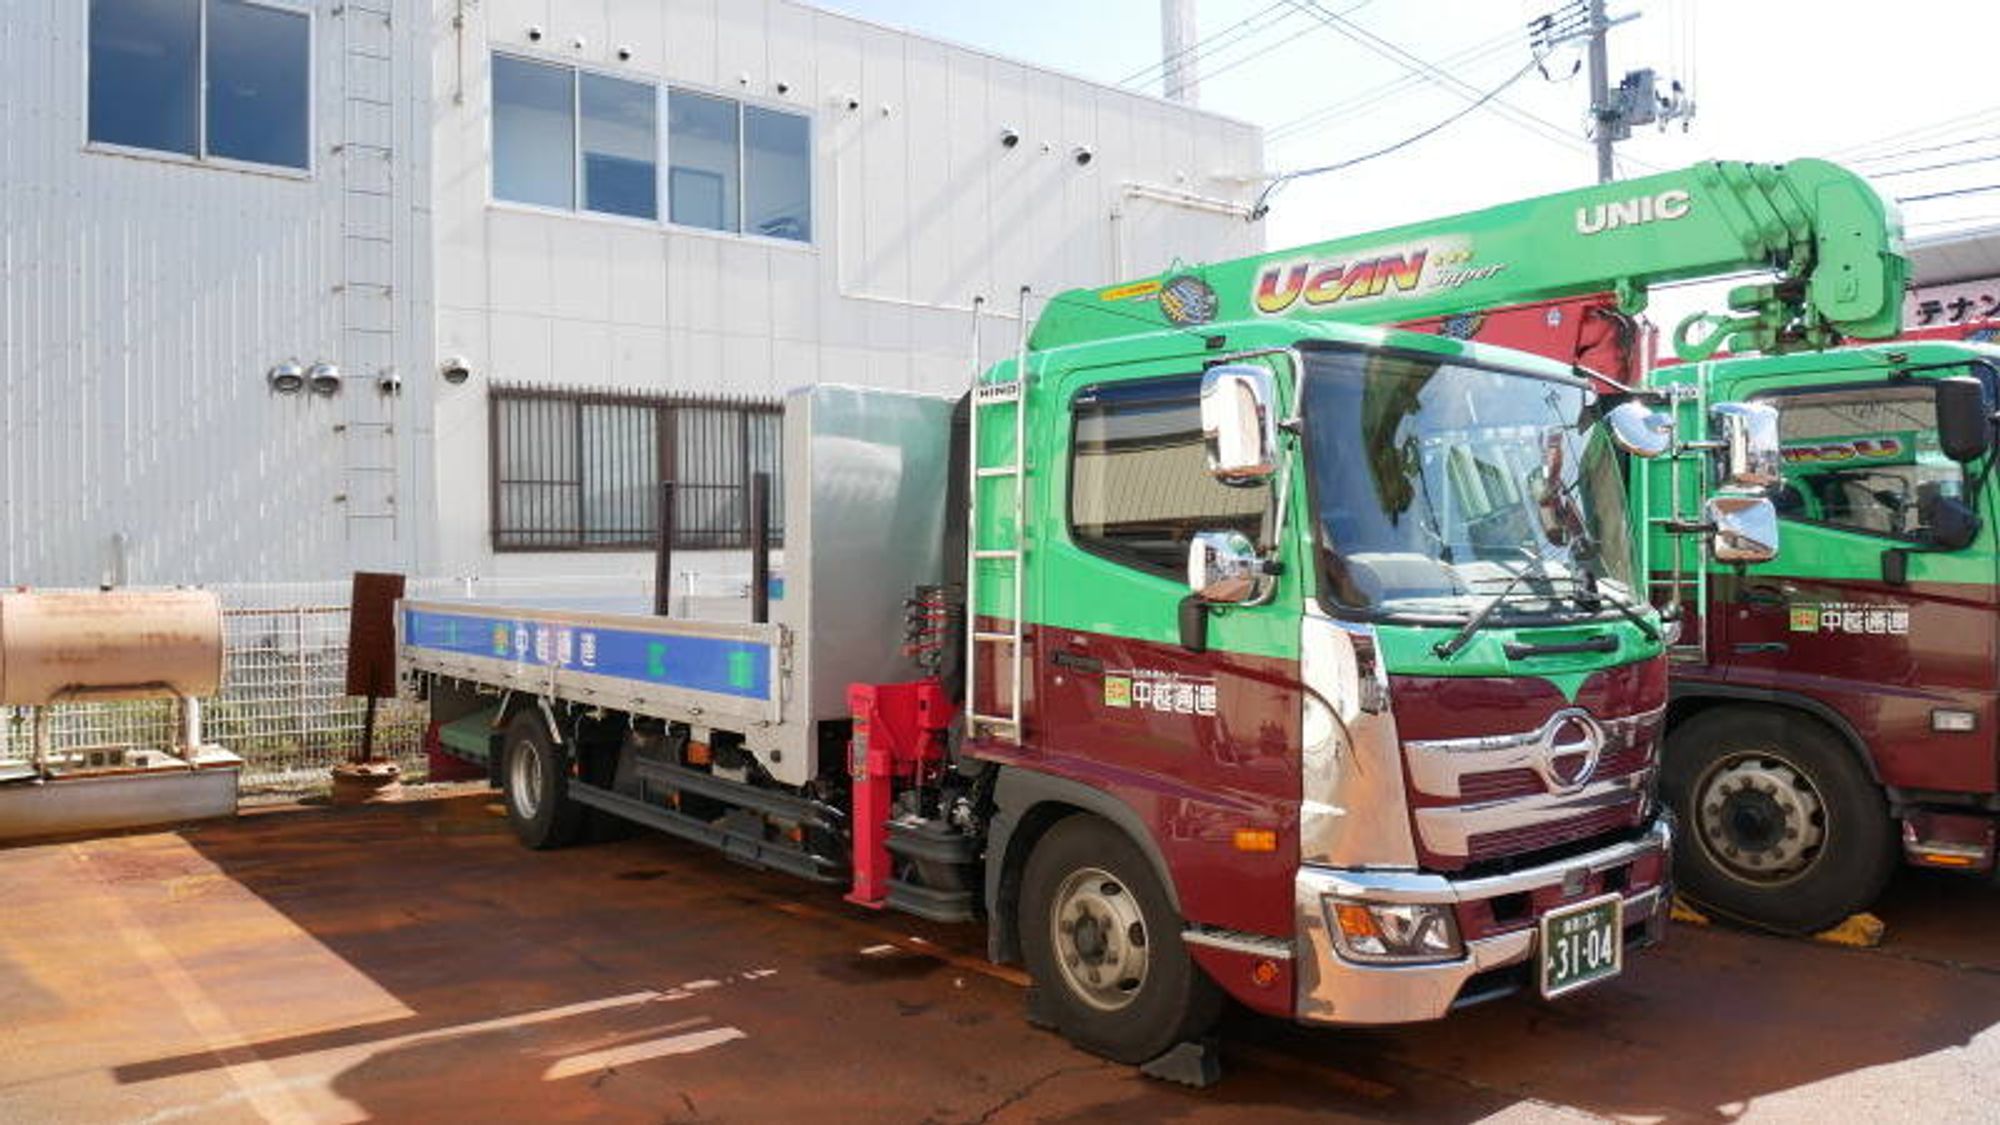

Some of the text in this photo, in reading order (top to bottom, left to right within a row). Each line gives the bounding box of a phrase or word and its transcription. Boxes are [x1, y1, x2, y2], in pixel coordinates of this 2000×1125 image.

[1577, 190, 1691, 235] UNIC
[1133, 681, 1217, 716] 中越通運
